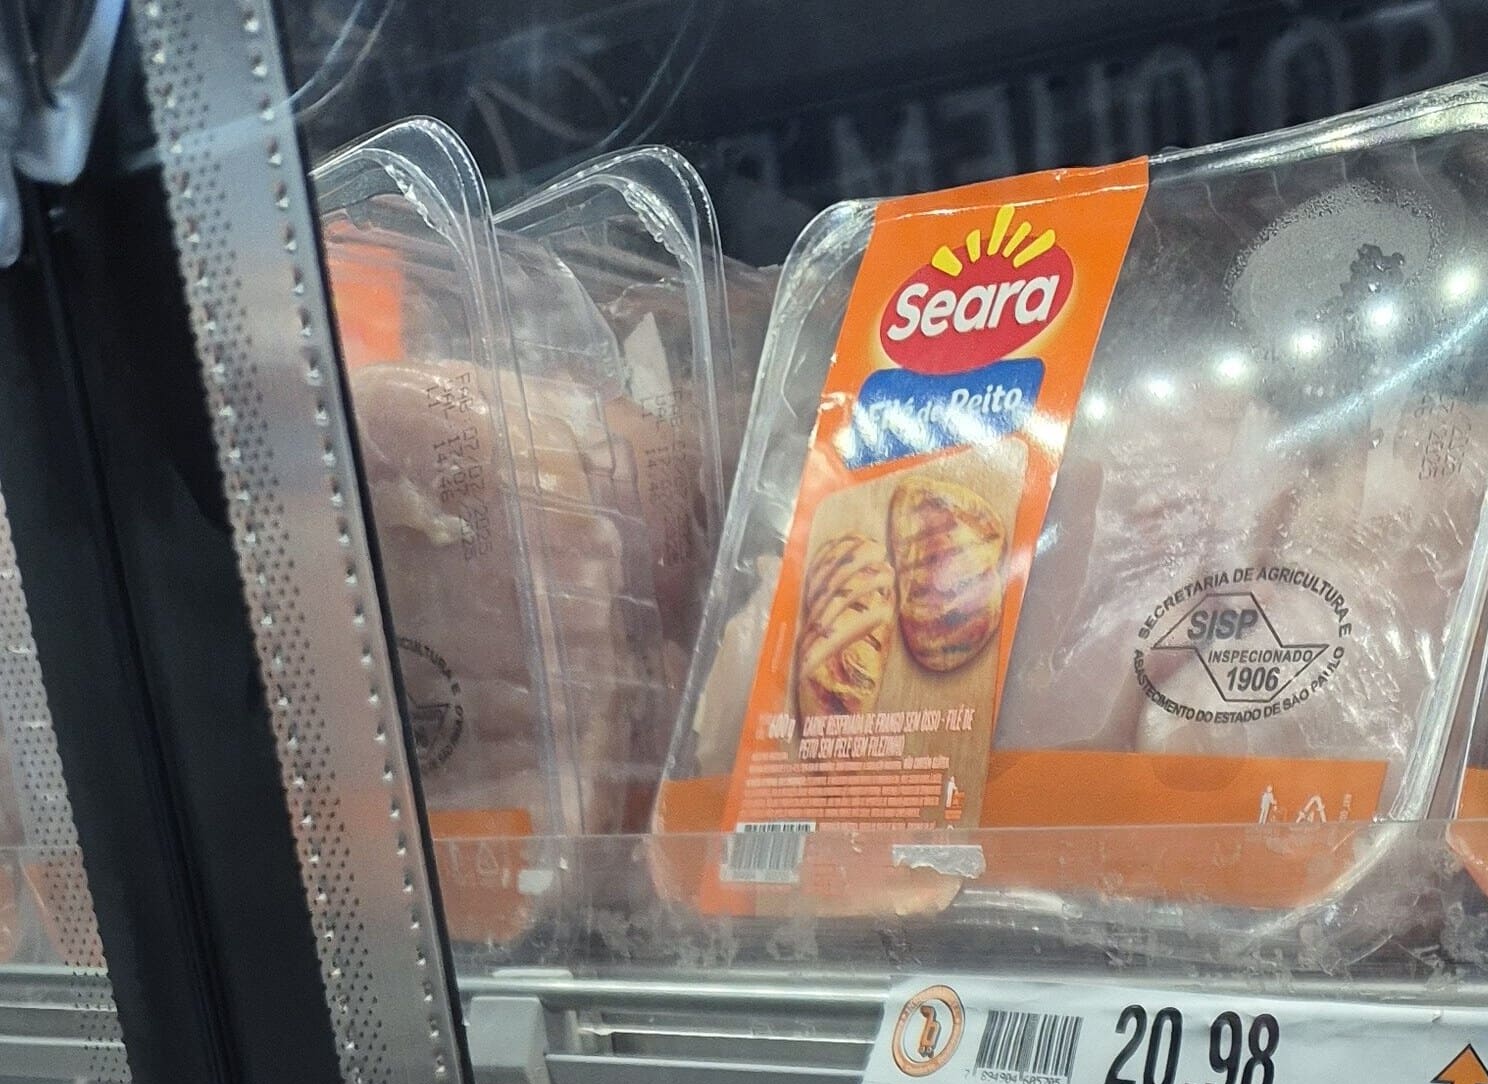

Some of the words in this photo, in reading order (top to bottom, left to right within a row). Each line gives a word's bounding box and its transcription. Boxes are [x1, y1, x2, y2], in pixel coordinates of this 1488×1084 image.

[886, 270, 1060, 342] Seara
[1138, 573, 1230, 640] SECRETARIA
[1233, 567, 1255, 582] DE
[1256, 566, 1352, 626] AGRICULTURA
[1338, 622, 1352, 638] E
[1187, 608, 1259, 642] SISP
[1207, 649, 1313, 664] INSPECIONADO
[1225, 666, 1281, 692] 1906
[1134, 649, 1196, 721] ABASTECIMENTO
[1195, 709, 1214, 723] DO
[1214, 708, 1262, 724] ESTADO
[1264, 704, 1281, 719] DE
[1311, 645, 1345, 693] PAULO
